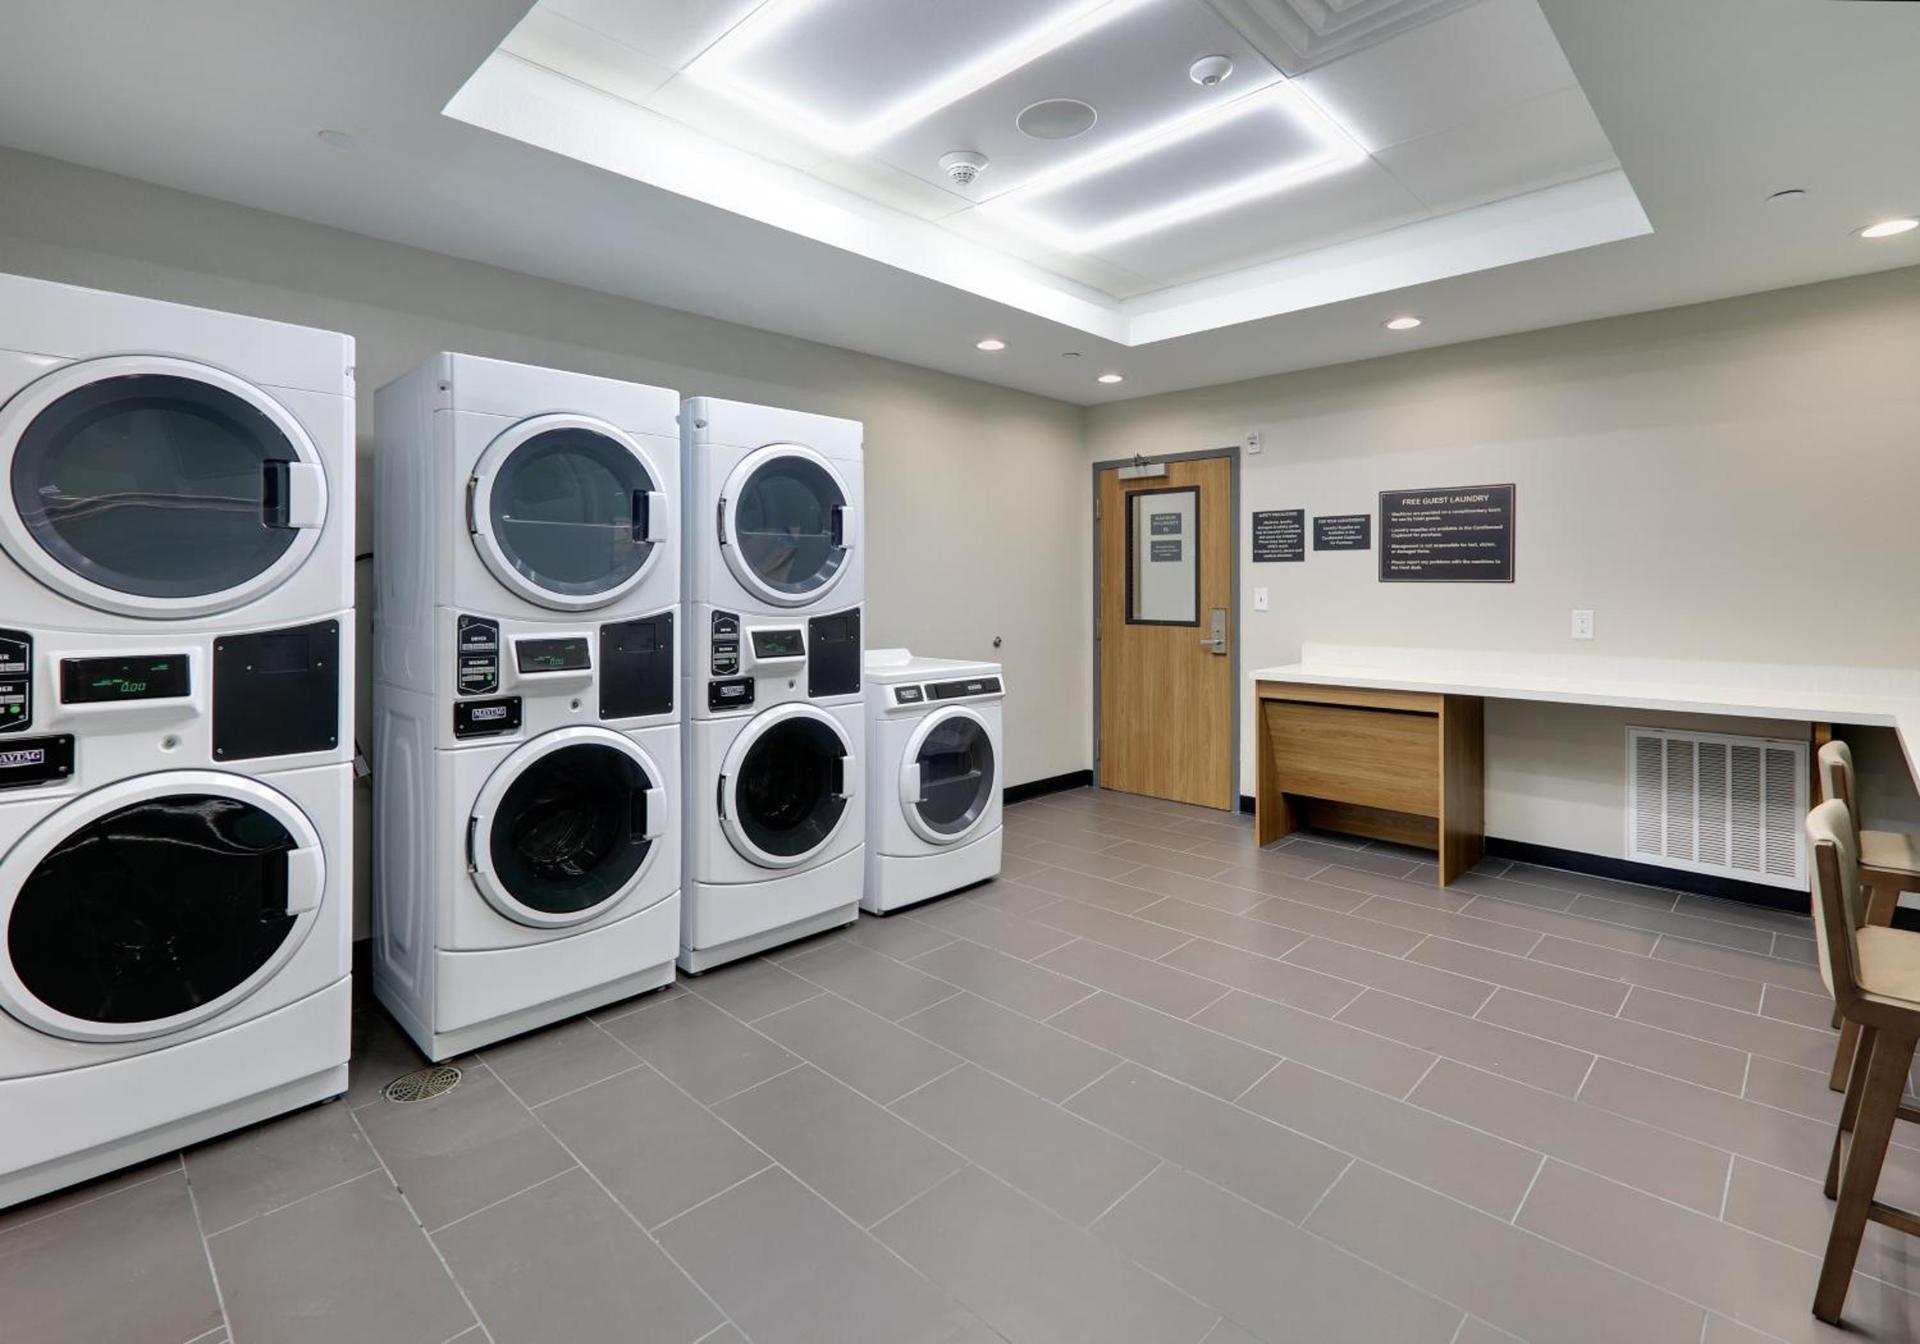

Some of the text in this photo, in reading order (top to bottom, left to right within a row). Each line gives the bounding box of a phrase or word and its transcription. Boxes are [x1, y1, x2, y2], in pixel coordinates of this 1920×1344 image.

[1422, 496, 1448, 505] GUEST
[1450, 494, 1490, 504] LAUNDRY
[0, 752, 40, 763] AYTAG
